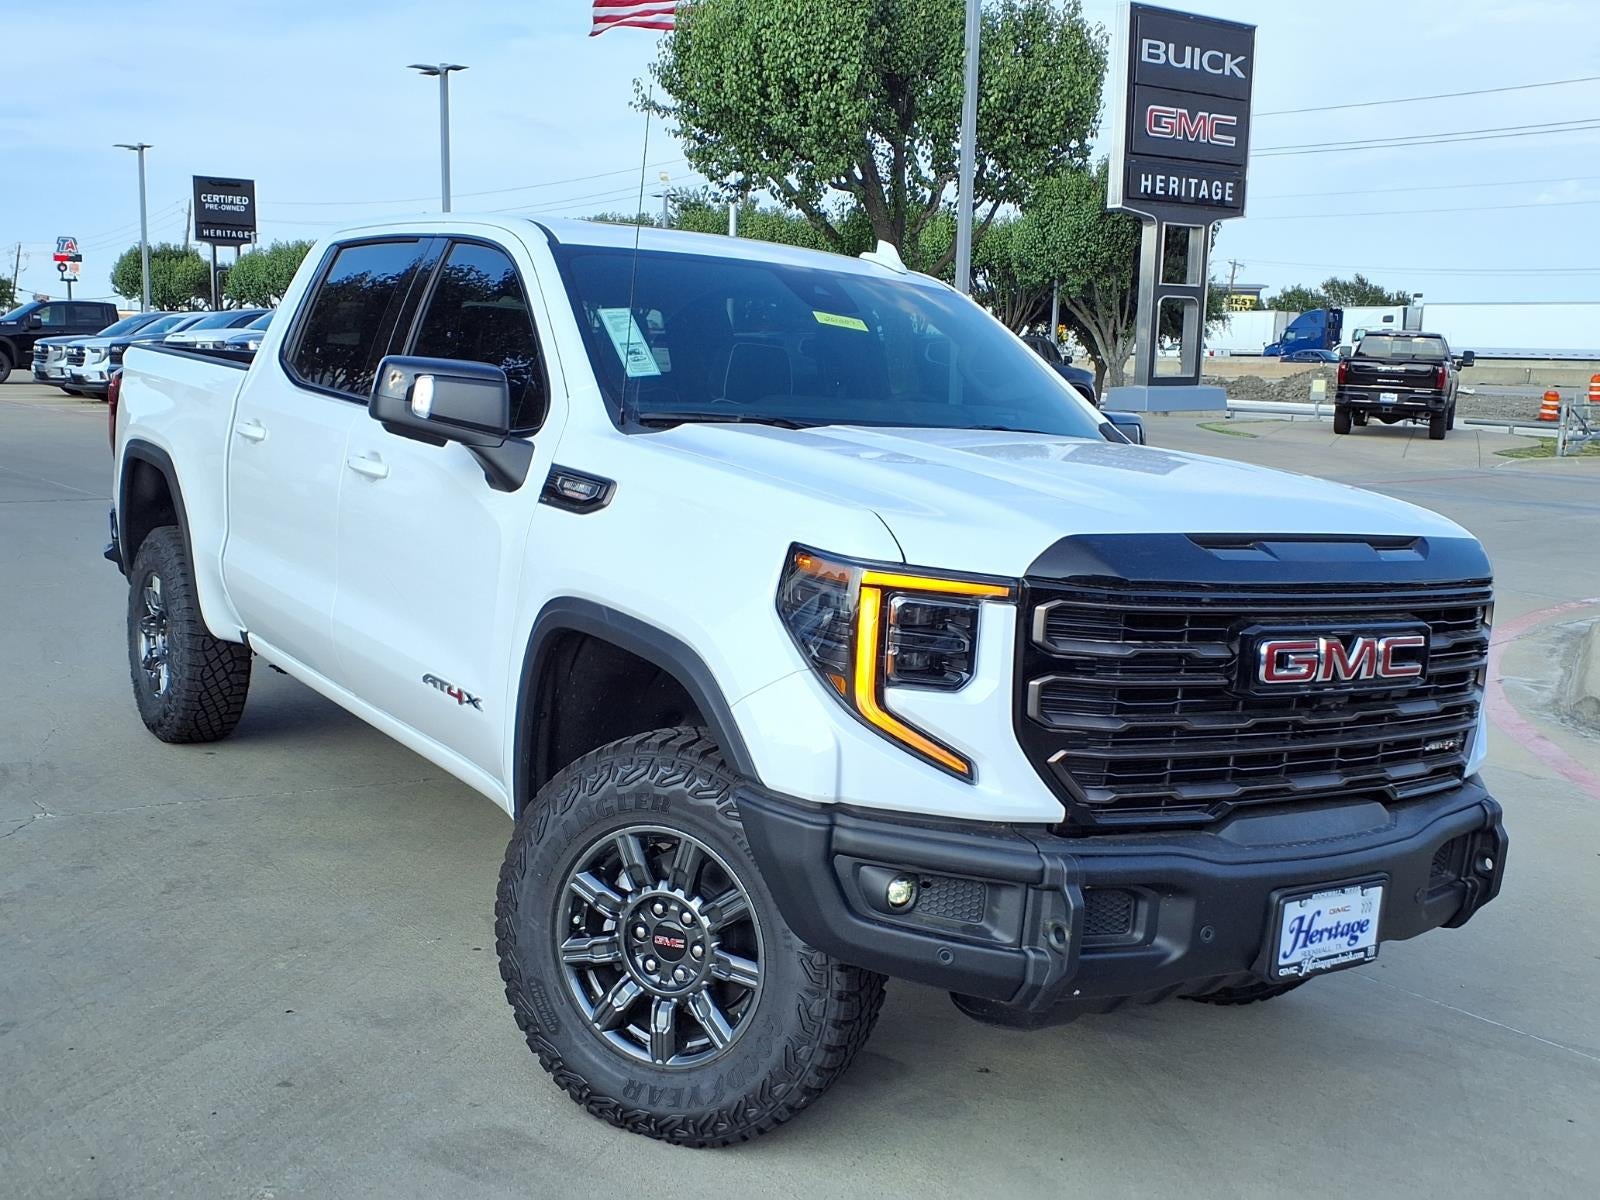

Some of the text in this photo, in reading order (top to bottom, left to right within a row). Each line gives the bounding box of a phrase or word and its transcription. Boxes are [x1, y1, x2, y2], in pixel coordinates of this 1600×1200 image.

[1141, 38, 1248, 79] BUICK
[1146, 104, 1238, 147] GMC
[200, 193, 249, 205] CERTIFIED
[1140, 173, 1234, 201] HERITAGE
[204, 203, 246, 212] PRE-OWNED
[58, 237, 78, 252] TA
[203, 229, 250, 239] HERITAGE
[1259, 636, 1425, 683] GMC
[422, 673, 484, 712] AT4X
[655, 935, 685, 949] GMC
[1282, 909, 1370, 959] Heritage
